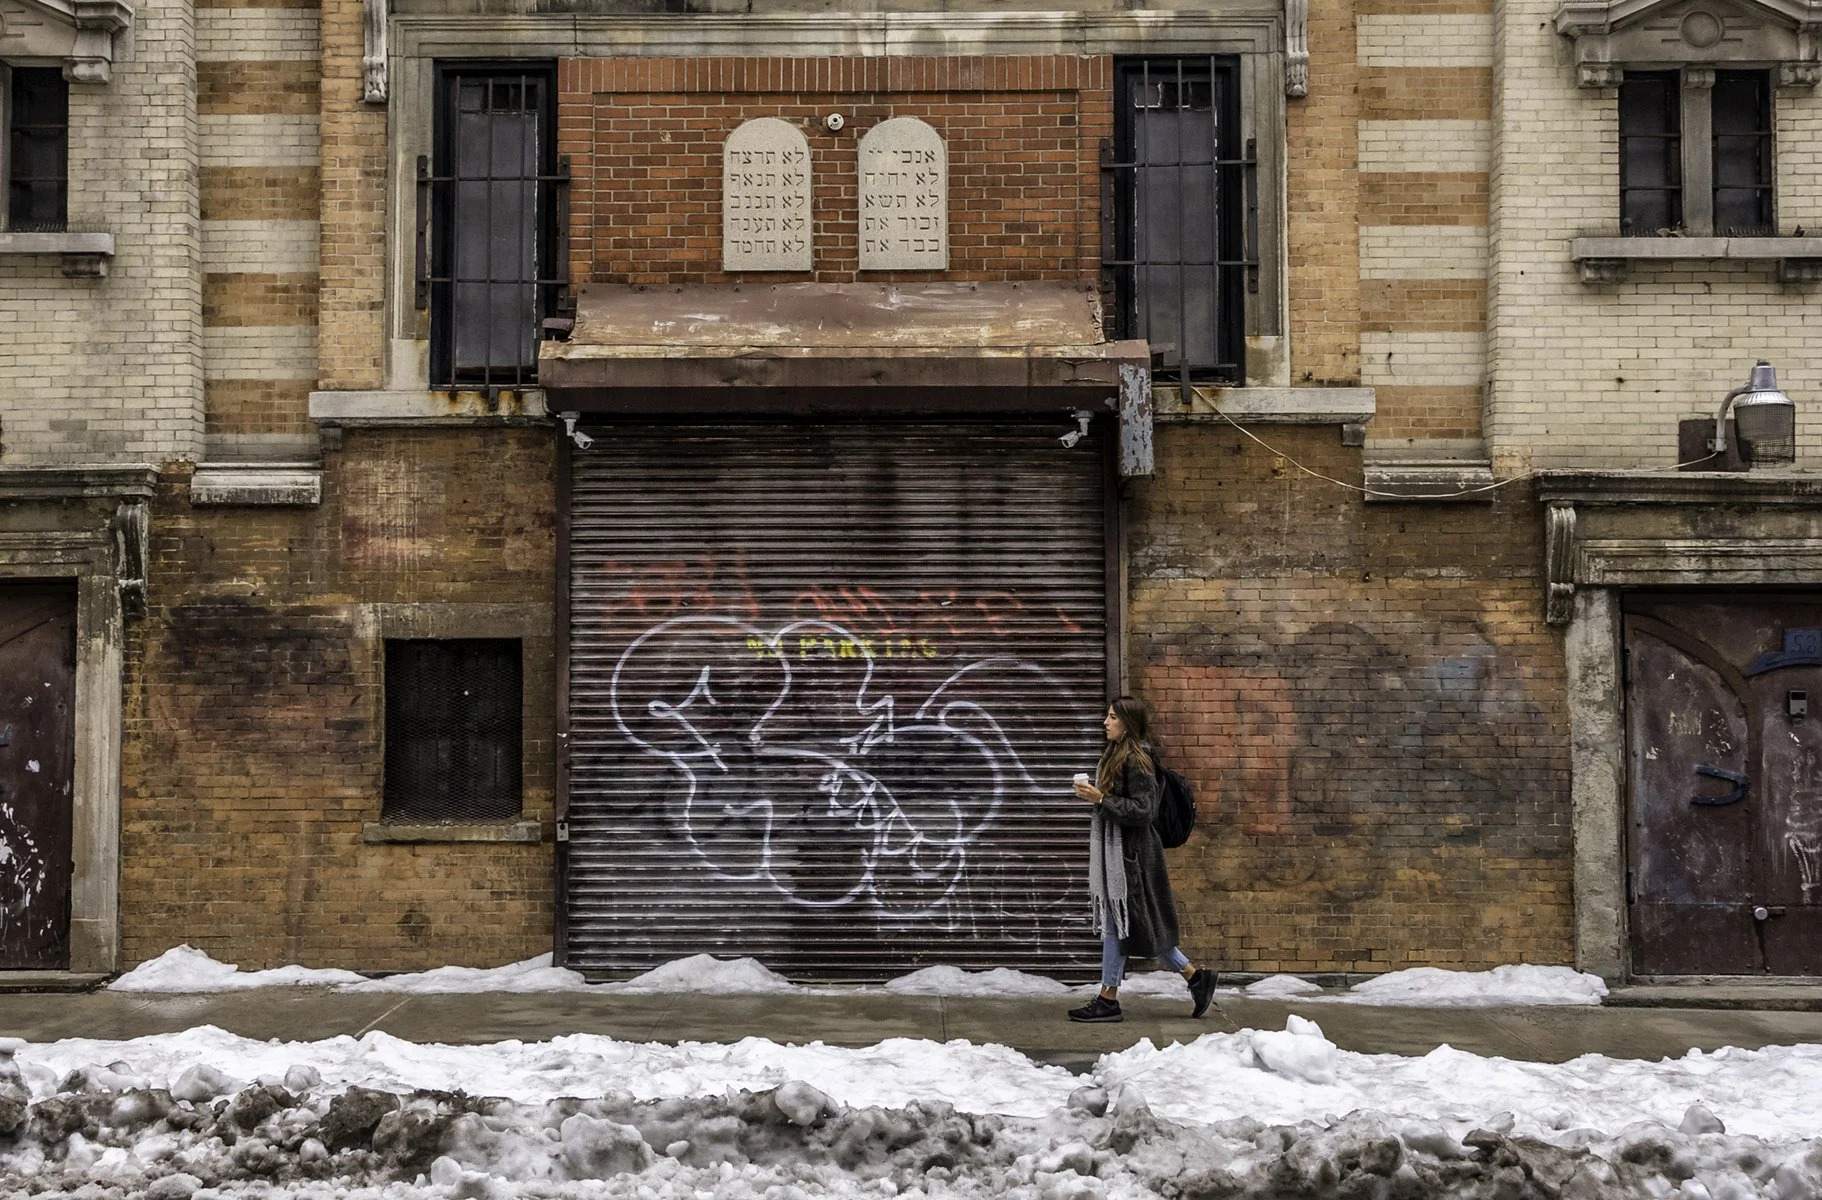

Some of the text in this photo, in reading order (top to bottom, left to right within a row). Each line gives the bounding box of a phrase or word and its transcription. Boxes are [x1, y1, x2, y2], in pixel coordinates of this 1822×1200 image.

[782, 146, 805, 164] לא
[782, 168, 805, 187] לא
[916, 167, 939, 185] לא
[782, 191, 805, 209] לא
[865, 189, 939, 208] לא תשא
[782, 213, 805, 231] לא
[865, 217, 889, 231] את
[782, 235, 805, 253] לא
[865, 239, 889, 253] את
